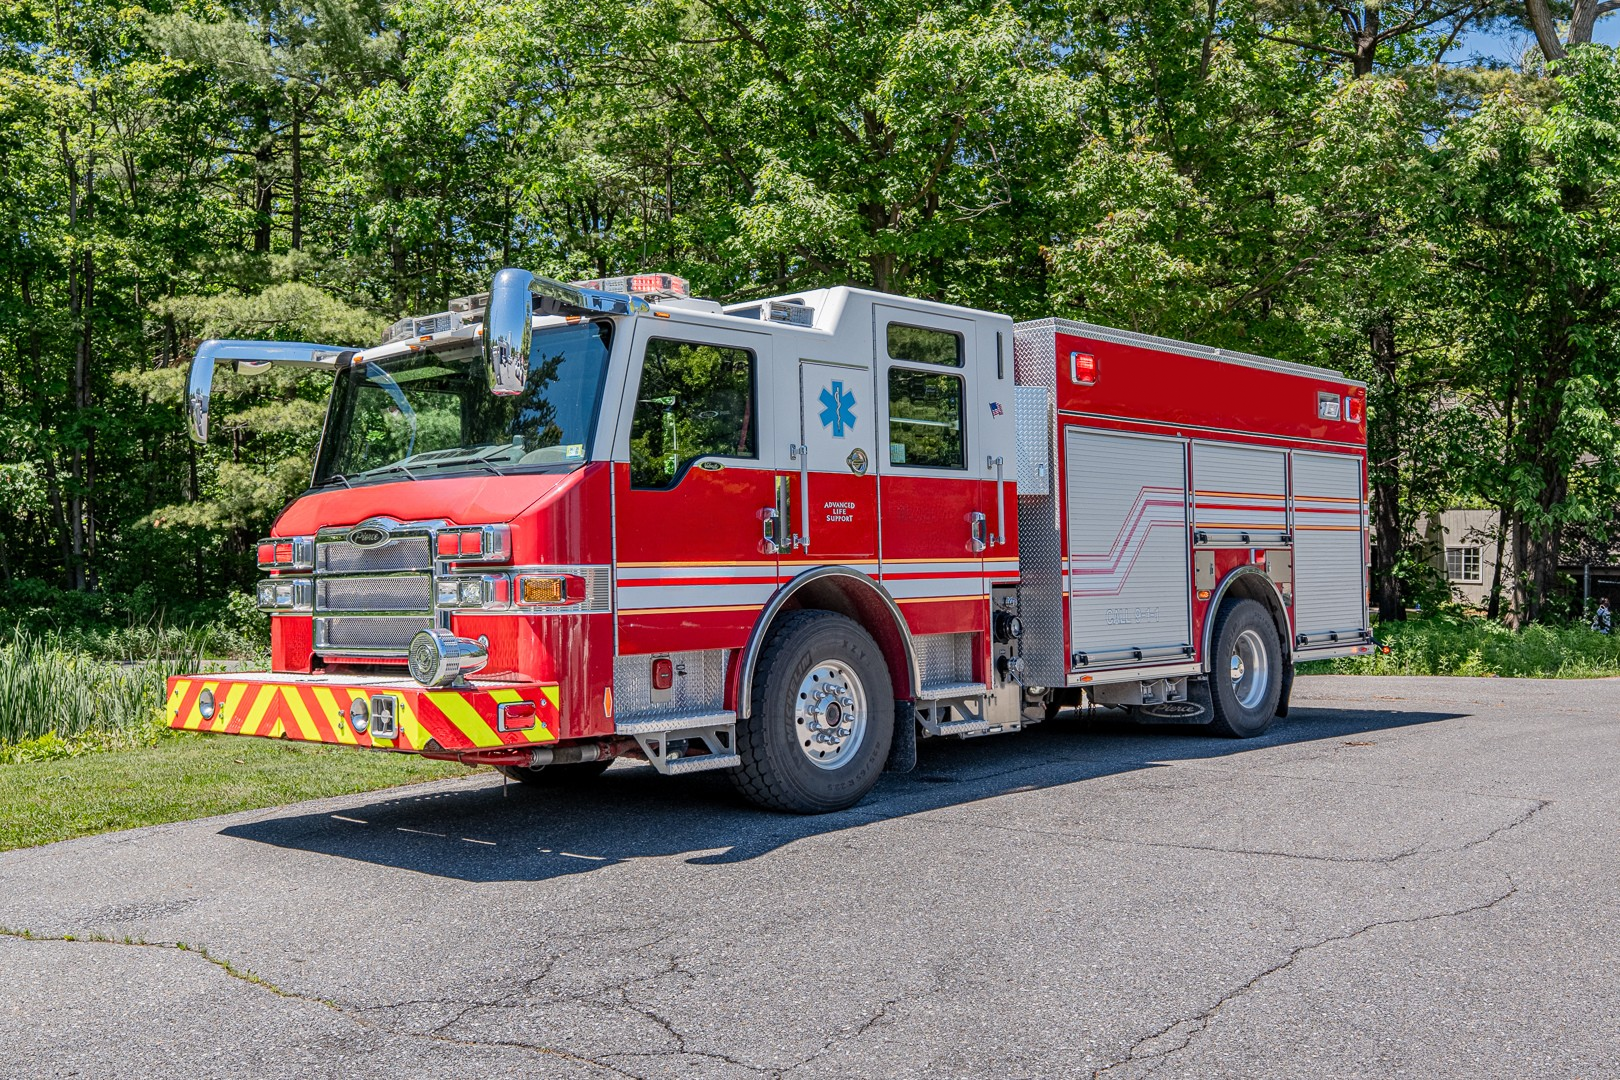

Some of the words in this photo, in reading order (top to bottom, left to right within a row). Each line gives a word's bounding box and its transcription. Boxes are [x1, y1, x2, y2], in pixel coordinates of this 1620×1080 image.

[355, 532, 380, 542] Pierce
[1105, 608, 1131, 626] CALL
[1135, 607, 1160, 624] 9-1-1
[784, 652, 812, 743] MICHELIN
[1151, 703, 1195, 714] Pierce
